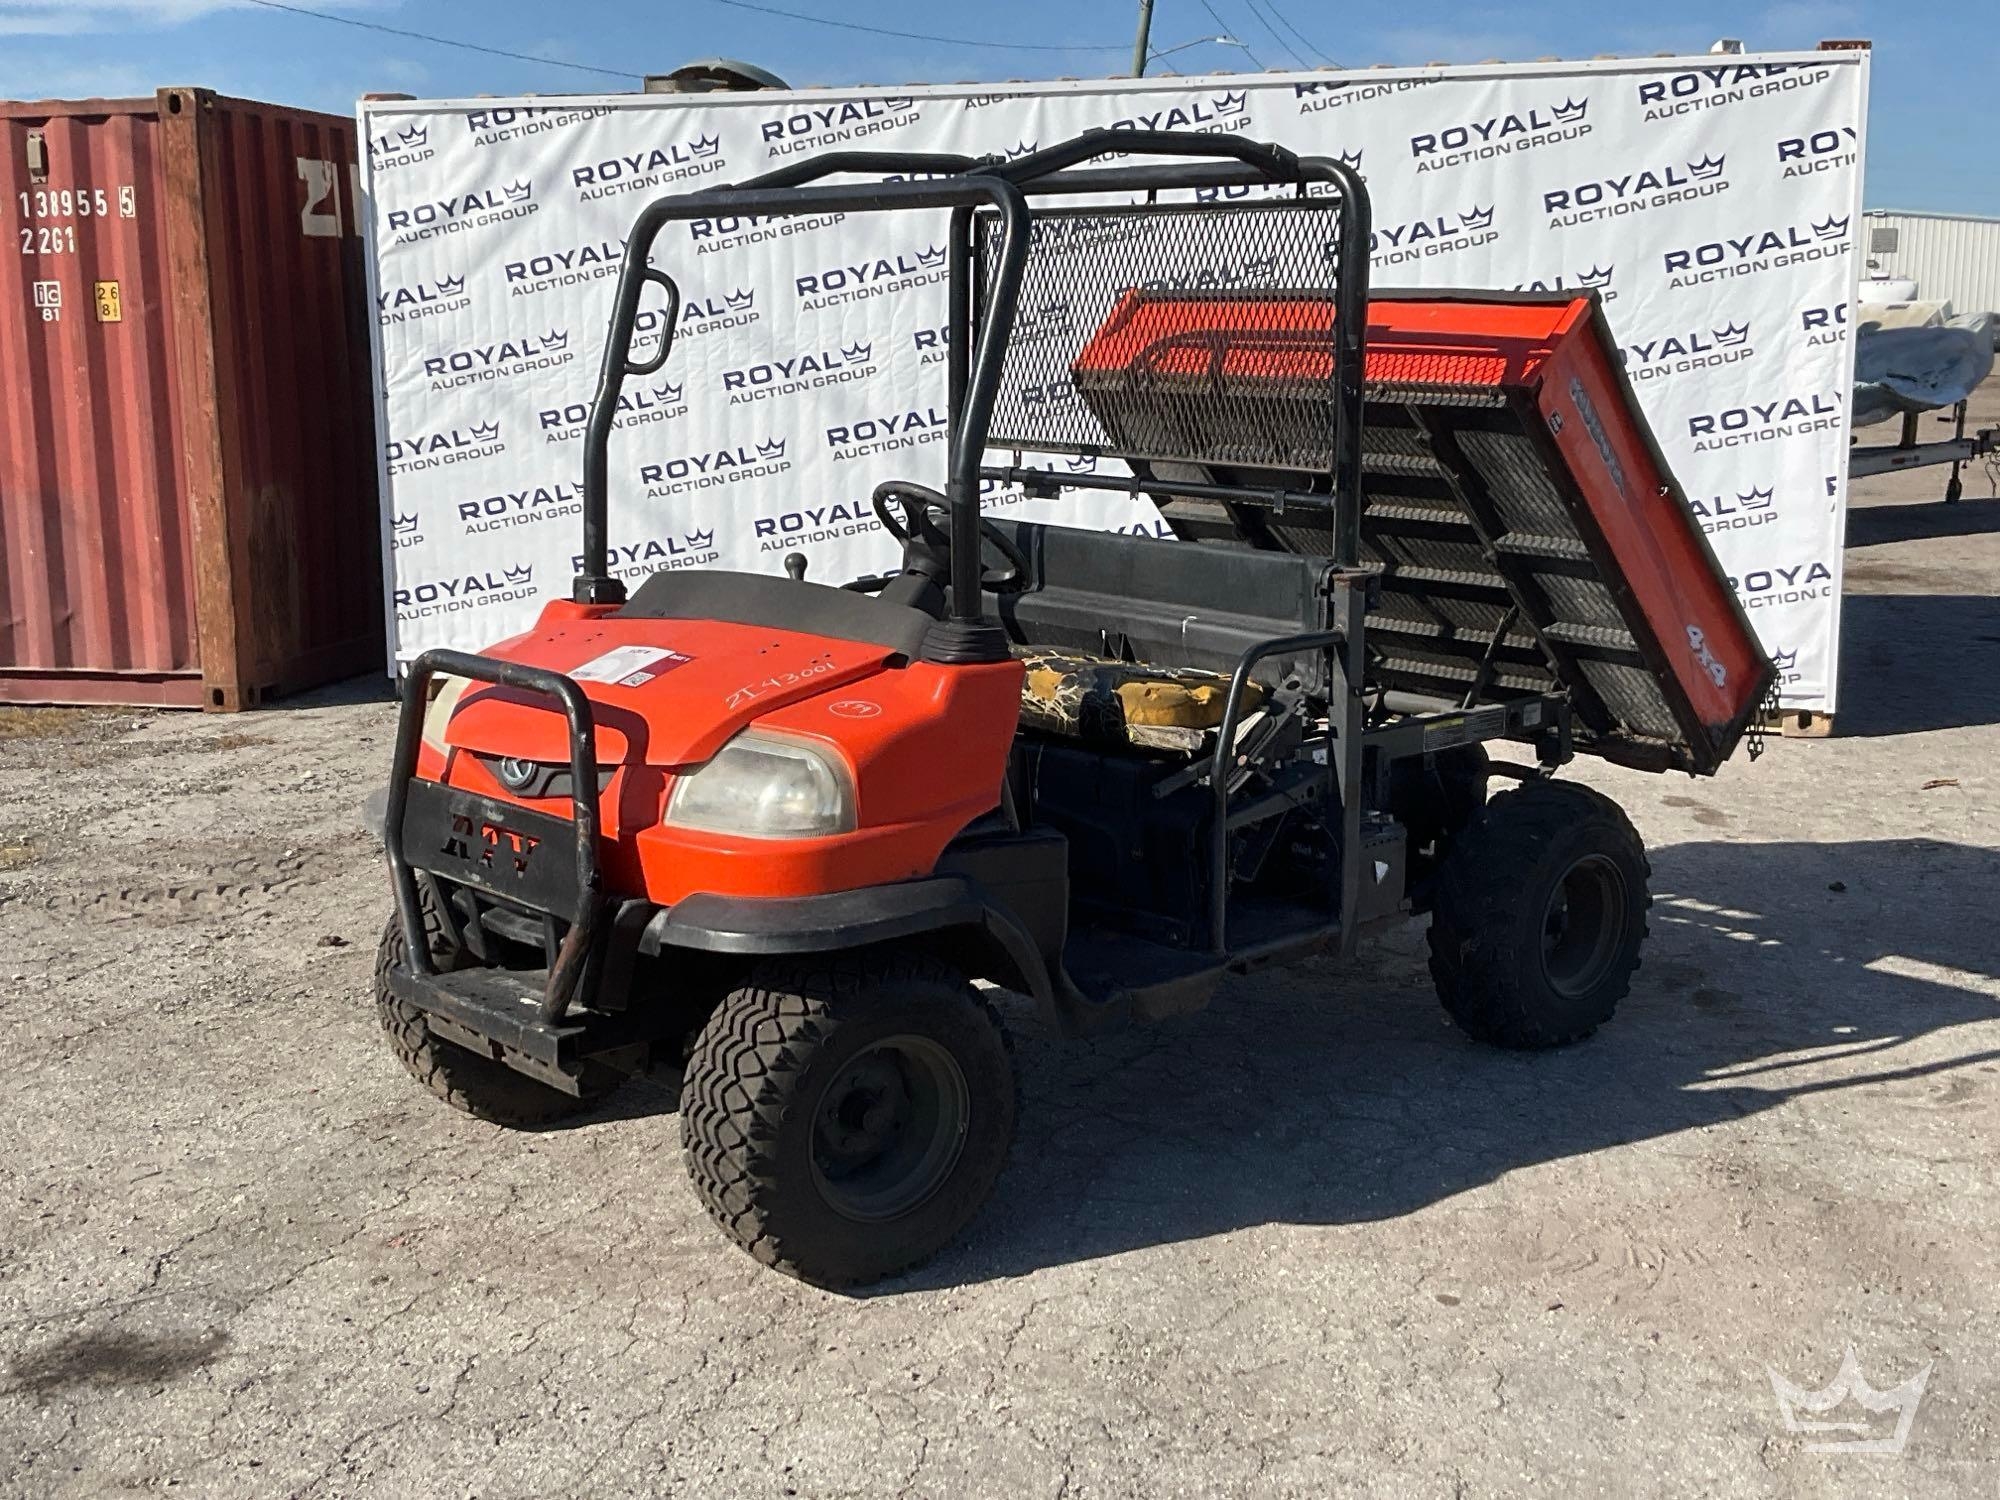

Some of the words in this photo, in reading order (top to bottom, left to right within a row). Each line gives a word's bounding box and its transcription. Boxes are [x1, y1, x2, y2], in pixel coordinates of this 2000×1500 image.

[1300, 83, 1392, 115] AUCTION
[1639, 63, 1787, 105] ROYAL
[1644, 89, 1744, 122] AUCTION
[1749, 70, 1830, 98] GROUP
[467, 107, 564, 132] ROY
[474, 119, 553, 147] AUCTION
[557, 105, 619, 127] GROUP
[762, 99, 883, 142] ROYAL
[768, 129, 850, 158] AUCTION
[855, 113, 920, 136] GROUP
[1111, 103, 1213, 131] OYAL
[1411, 110, 1551, 158] ROYAL
[572, 145, 690, 187] ROYAL
[1416, 143, 1510, 174] AUCTION
[1516, 124, 1592, 150] GROUP
[1783, 153, 1855, 179] AUCTI
[579, 175, 659, 202] AUCTION
[662, 159, 726, 183] GROUP
[1544, 167, 1687, 213] ROYAL
[20, 189, 107, 218] 138955
[120, 187, 134, 216] 5
[388, 190, 504, 230] ROYAL
[1550, 199, 1646, 229] AUCTION
[1652, 181, 1729, 207] GROUP
[20, 226, 75, 254] 22G1
[395, 218, 473, 246] AUCTION
[477, 203, 539, 226] GROUP
[697, 228, 776, 255] AUCTION
[781, 213, 845, 236] GROUP
[505, 242, 621, 282] ROYAL
[1370, 248, 1420, 268] TION
[1425, 231, 1498, 256] GROUP
[1664, 227, 1811, 273] ROYAL
[512, 271, 589, 297] AUCTION
[796, 256, 916, 296] ROYAL
[1669, 259, 1768, 289] AUCTION
[42, 307, 60, 321] 81
[409, 297, 471, 320] GROUP
[803, 285, 883, 312] AUCTION
[629, 327, 693, 349] UCTON
[696, 312, 759, 334] GROUP
[425, 339, 540, 377] ROYAL
[430, 365, 509, 391] AUCTION
[513, 352, 574, 375] GROUP
[723, 352, 842, 391] ROYAL
[1677, 349, 1754, 373] GROUP
[730, 380, 809, 405] AUCTION
[813, 366, 876, 388] GROUP
[539, 392, 654, 429] ROAL
[627, 406, 688, 427] GROUP
[827, 408, 947, 446] ROYAL
[1688, 394, 1834, 438] ROYAL
[444, 444, 505, 464] GROUP
[833, 436, 914, 461] AUCTION
[1693, 426, 1792, 453] AUCTION
[641, 447, 756, 484] ROYAL
[647, 475, 725, 499] AUCTION
[729, 461, 791, 482] GROUP
[458, 485, 572, 521] ROYAL
[465, 510, 542, 535] AUCTION
[546, 503, 582, 519] GRO
[755, 501, 872, 538] ROYAL
[760, 528, 839, 552] AUCTION
[844, 516, 906, 536] GROP
[608, 564, 654, 579] TION
[658, 552, 719, 572] GROUP
[393, 573, 504, 608] ROYAL
[397, 600, 473, 622] AUCTION
[477, 587, 538, 605] GROUP
[1743, 586, 1816, 609] CTION
